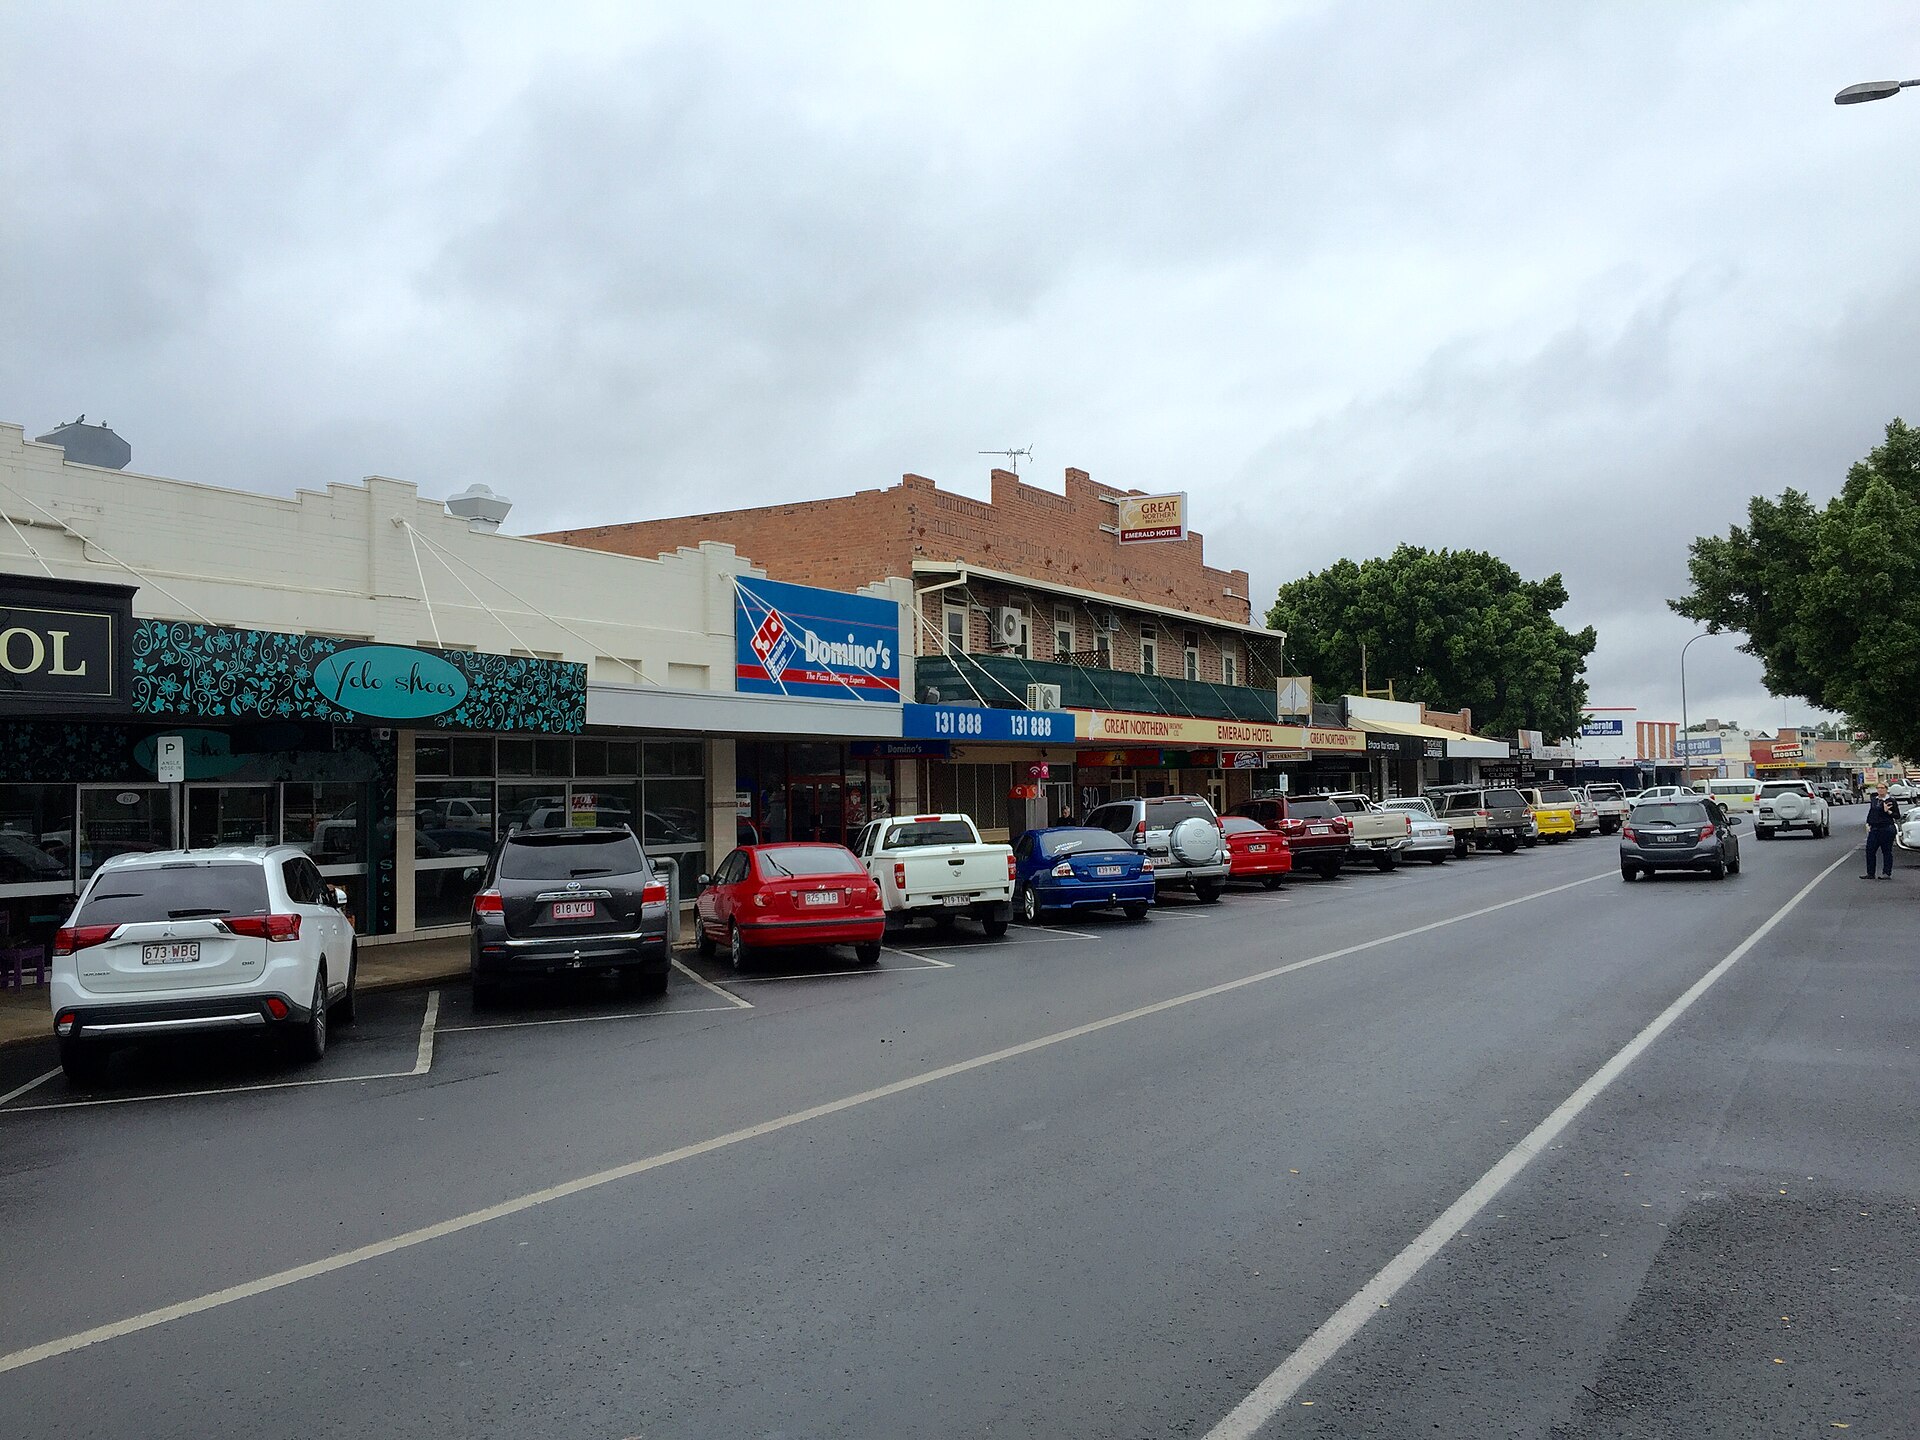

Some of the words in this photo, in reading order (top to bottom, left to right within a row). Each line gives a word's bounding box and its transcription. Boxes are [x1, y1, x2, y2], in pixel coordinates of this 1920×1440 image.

[1141, 501, 1177, 513] GREAT
[1142, 511, 1177, 520] NORTHERN
[1125, 531, 1155, 539] EMERALD
[1156, 529, 1178, 537] HOTEL
[805, 630, 891, 670] Domino's
[330, 659, 383, 701] Yolo
[395, 661, 456, 697] shoes
[806, 671, 816, 680] The
[816, 672, 829, 681] Pizza
[849, 675, 866, 684] Experts
[935, 711, 954, 733] 131
[958, 712, 981, 734] 888
[1011, 715, 1027, 736] 131
[1031, 717, 1051, 737] 888
[1104, 718, 1129, 734] GREAT
[1130, 721, 1169, 736] NORTHERN
[1583, 721, 1613, 730] Emerald
[1217, 725, 1251, 741] EMERALD
[1252, 728, 1273, 742] HOTEL
[165, 743, 175, 755] P
[887, 744, 922, 754] Domino's
